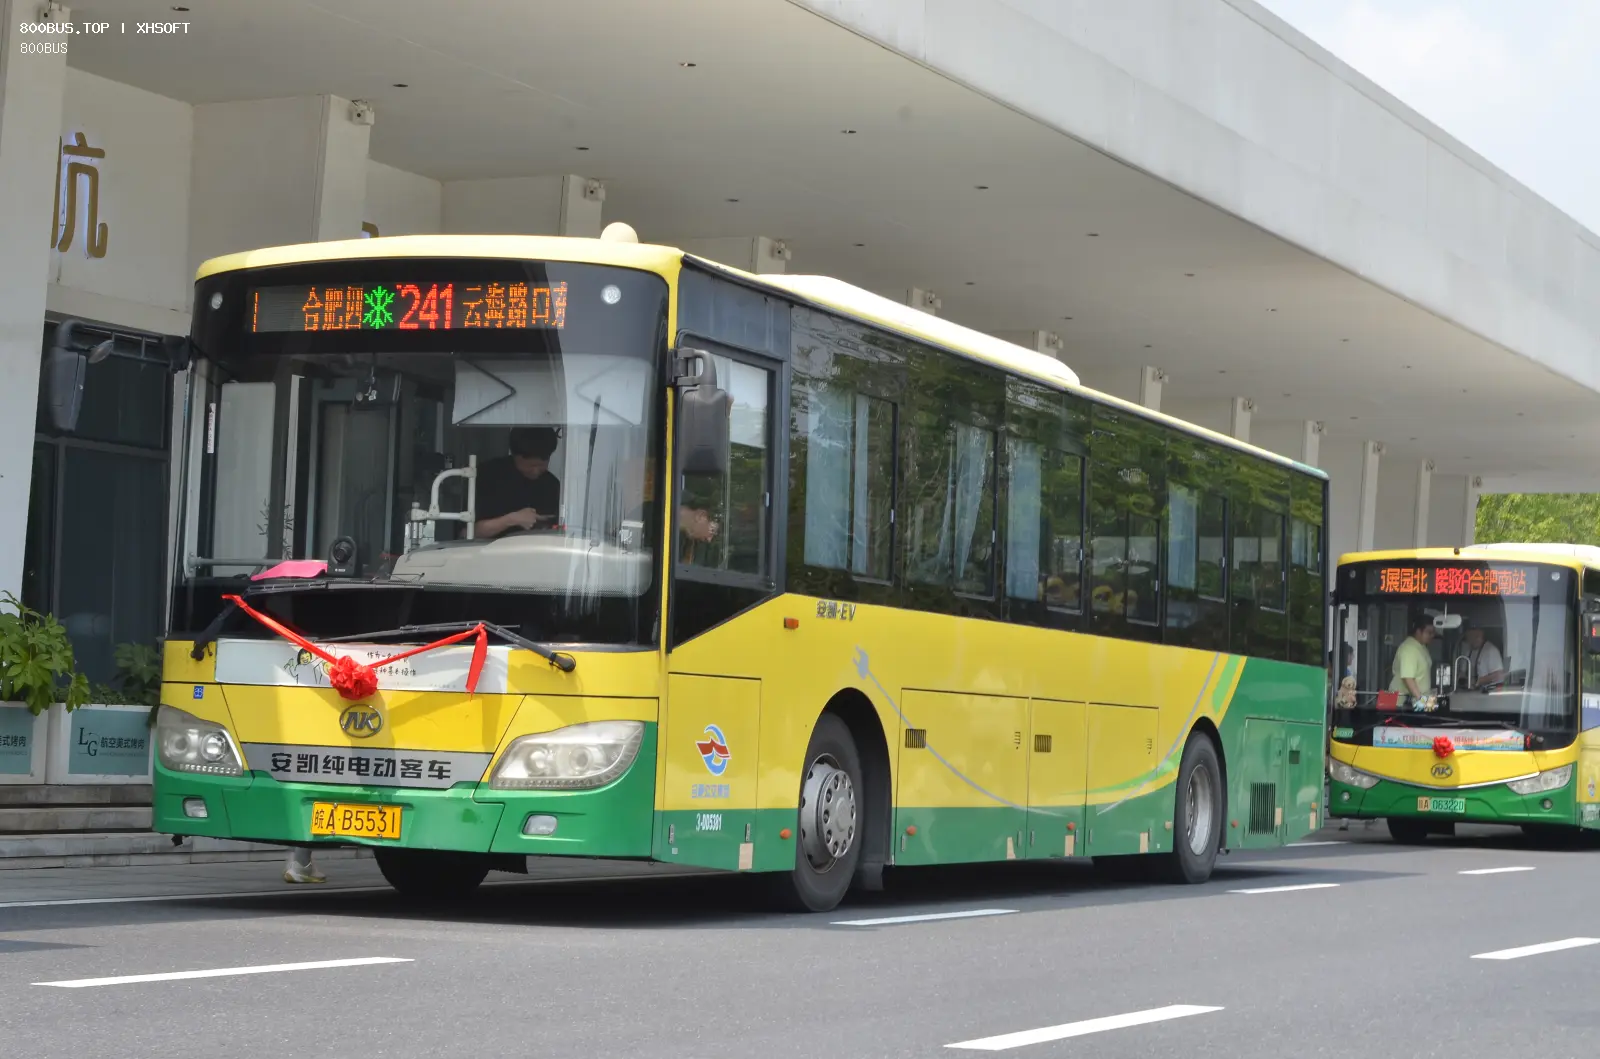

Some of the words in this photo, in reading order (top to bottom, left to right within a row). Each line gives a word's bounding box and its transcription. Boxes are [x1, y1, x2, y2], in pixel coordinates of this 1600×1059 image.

[396, 283, 453, 330] 241
[270, 752, 452, 780] 安凯纯电动客车
